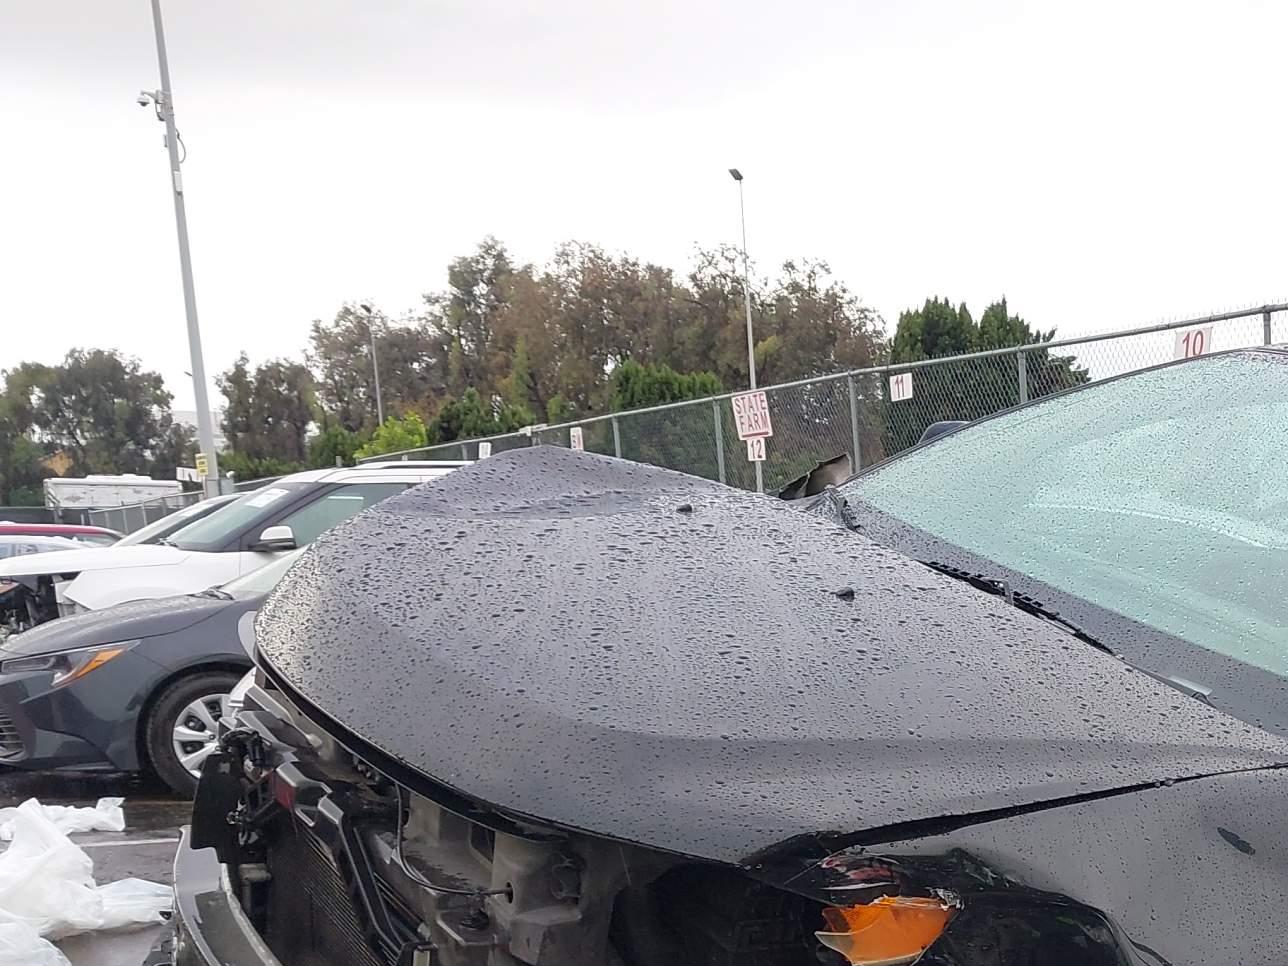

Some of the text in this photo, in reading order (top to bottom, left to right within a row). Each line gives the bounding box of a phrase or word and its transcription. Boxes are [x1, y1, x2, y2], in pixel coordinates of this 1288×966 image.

[1182, 331, 1204, 357] 10
[895, 375, 904, 398] 11
[734, 393, 767, 414] STATE
[739, 411, 769, 432] FARM
[750, 440, 763, 459] 12
